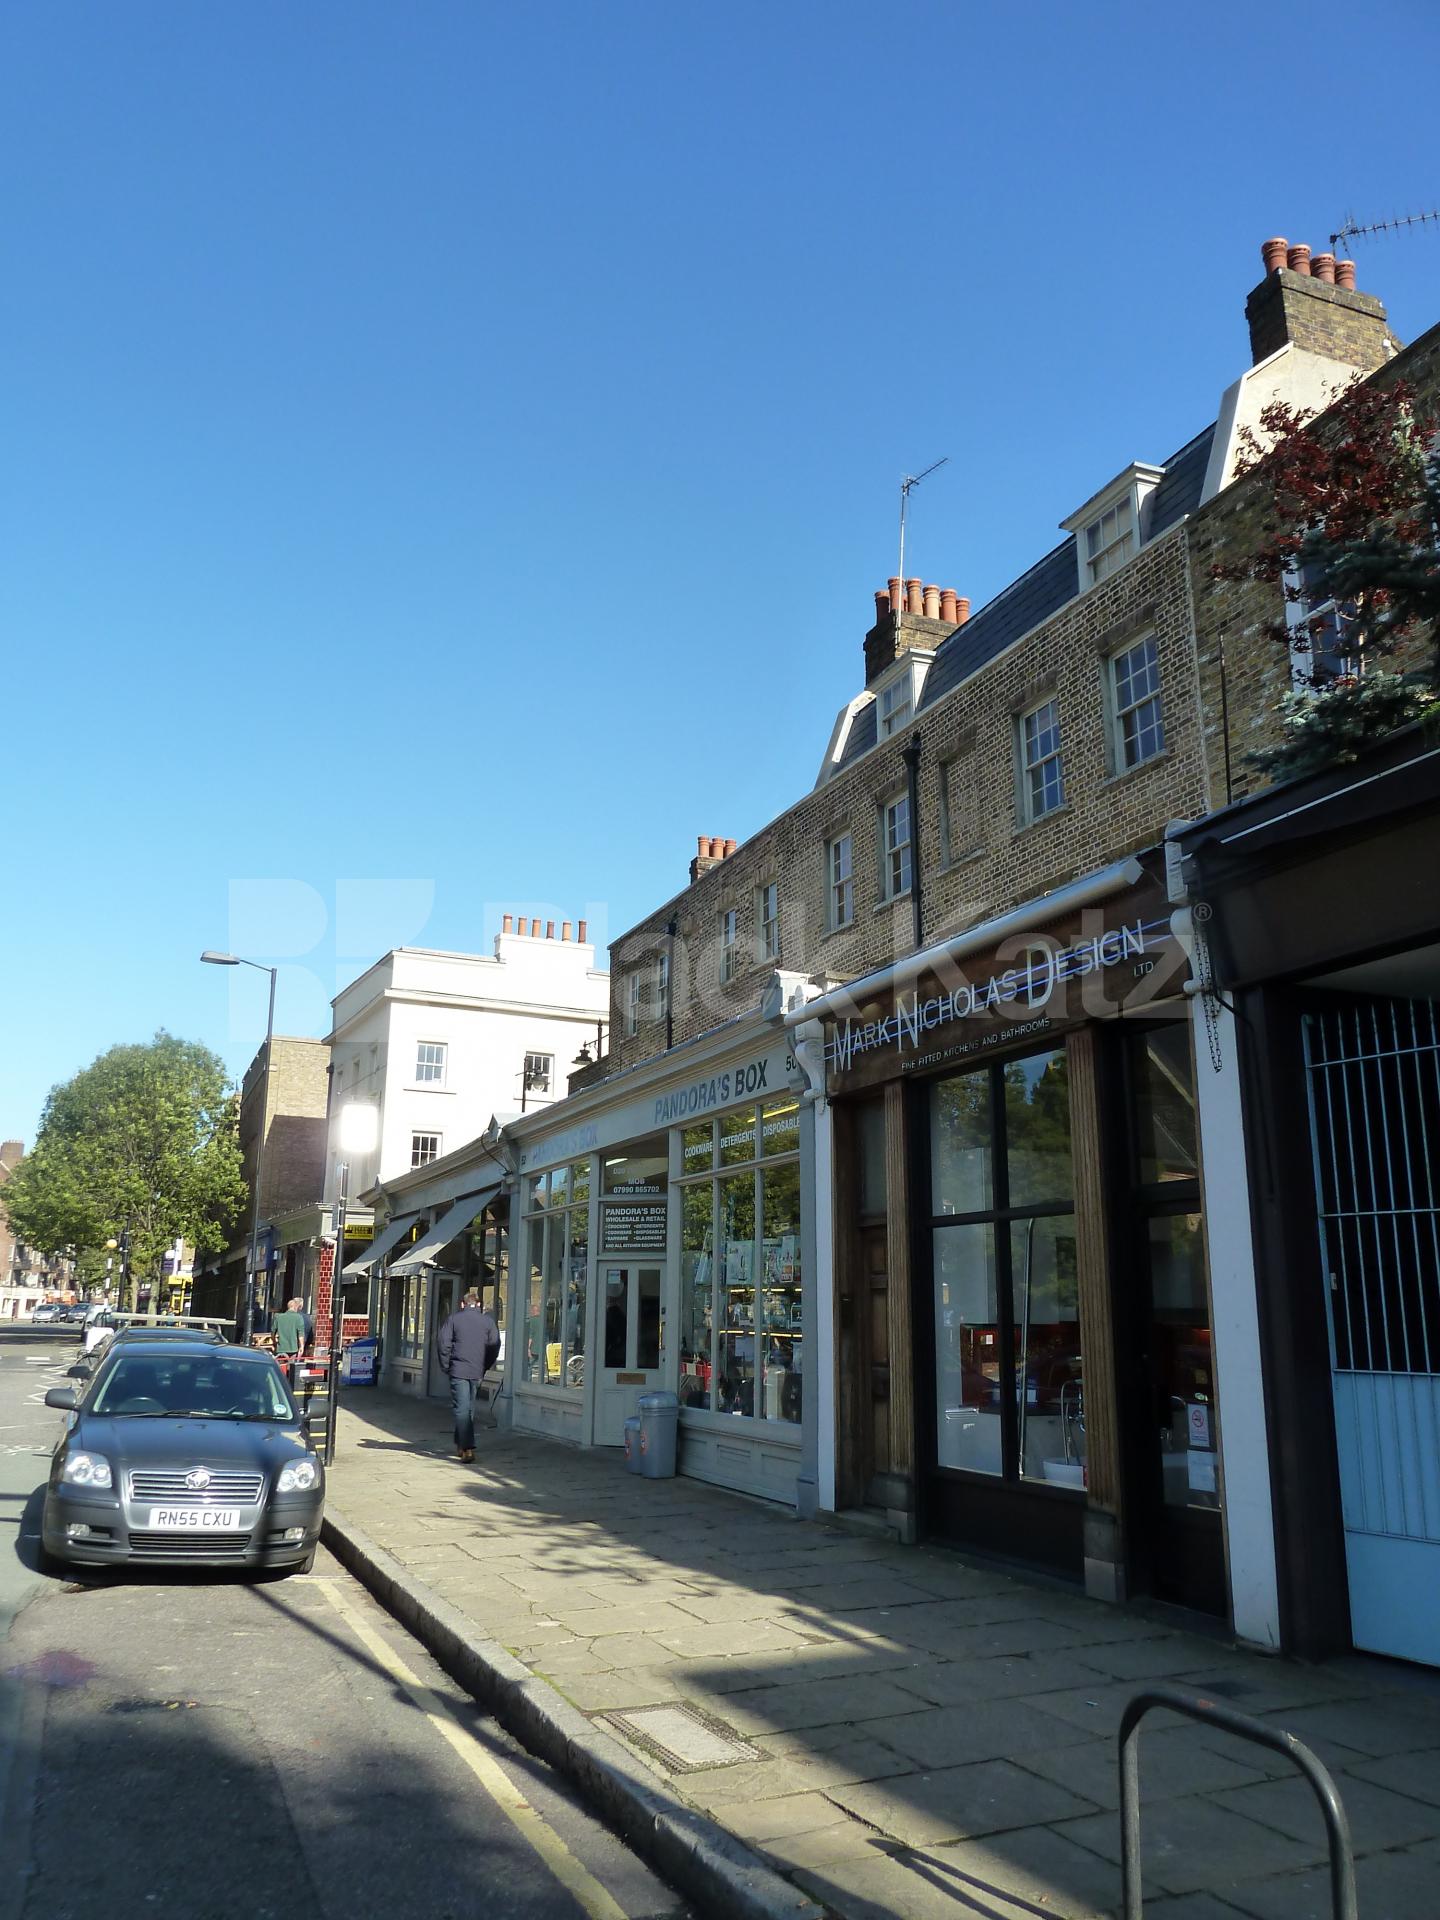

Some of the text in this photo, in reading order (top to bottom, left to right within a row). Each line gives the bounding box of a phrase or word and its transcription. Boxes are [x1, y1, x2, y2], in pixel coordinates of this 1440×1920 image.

[1133, 961, 1154, 977] LTD
[833, 919, 1144, 1075] MARK NICHOLAS DESIGN
[901, 1017, 1050, 1072] FINE FITTED KITCHENS AND BATHROOMS
[654, 1059, 768, 1124] PANDORA'S BOX
[684, 1141, 713, 1158] COOKWARE
[650, 1207, 666, 1215] BOX
[158, 1511, 232, 1526] RN55 CXU
